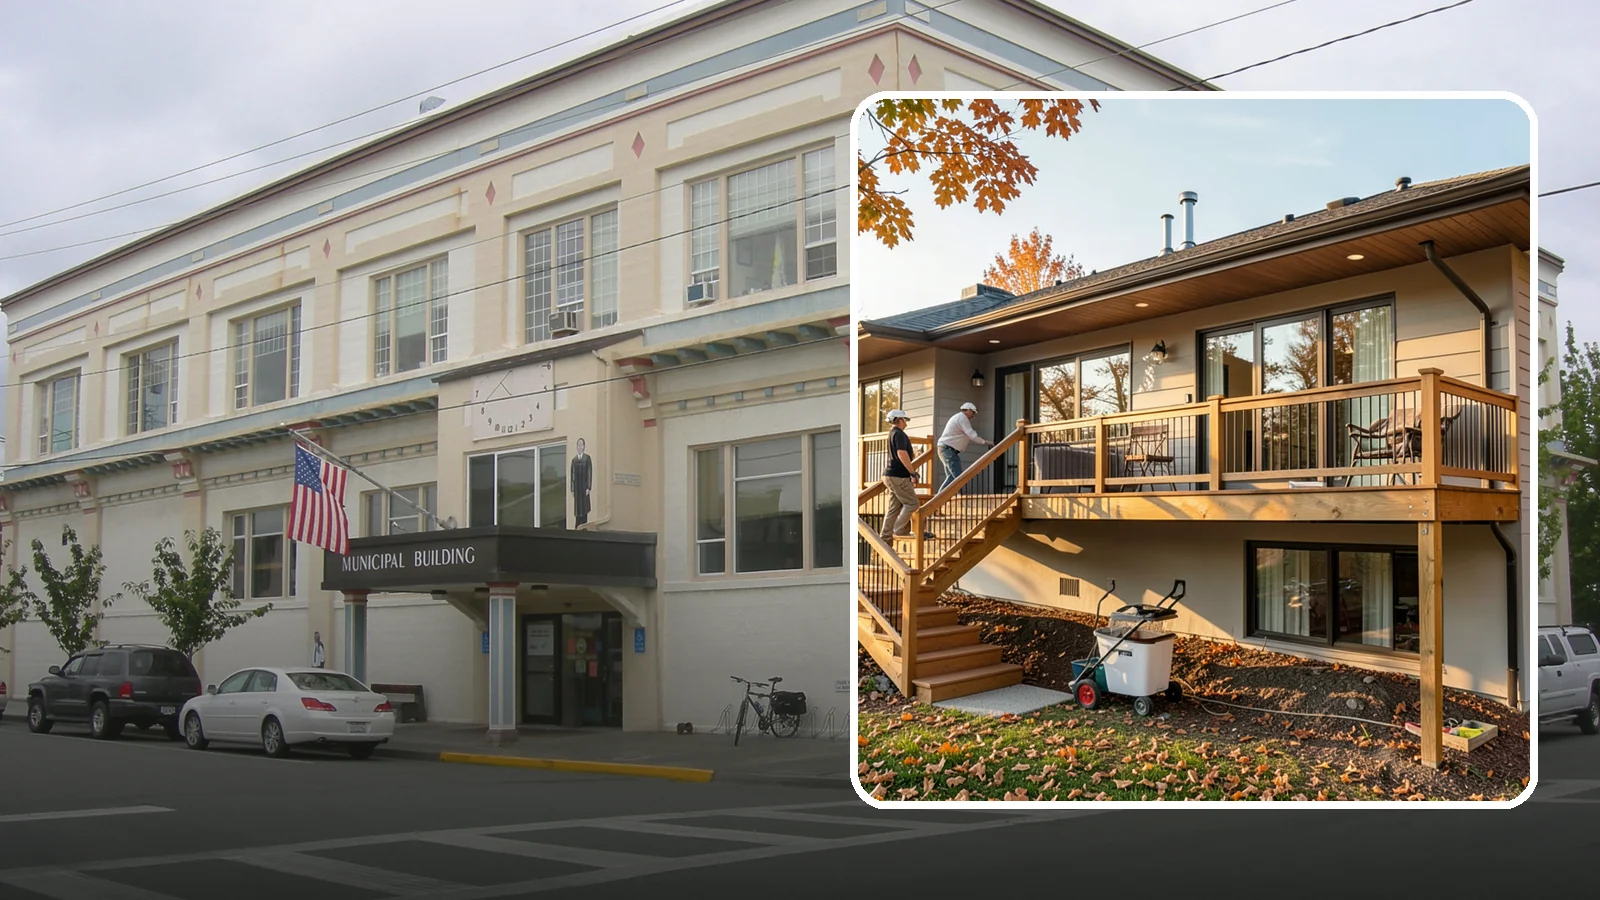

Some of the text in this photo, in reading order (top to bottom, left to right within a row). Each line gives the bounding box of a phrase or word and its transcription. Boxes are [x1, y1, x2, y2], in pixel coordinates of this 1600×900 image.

[546, 362, 551, 370] 6
[536, 402, 540, 410] 4
[480, 407, 485, 415] 8
[488, 418, 492, 426] 9
[341, 546, 475, 572] MUNICIPAL BUILDING
